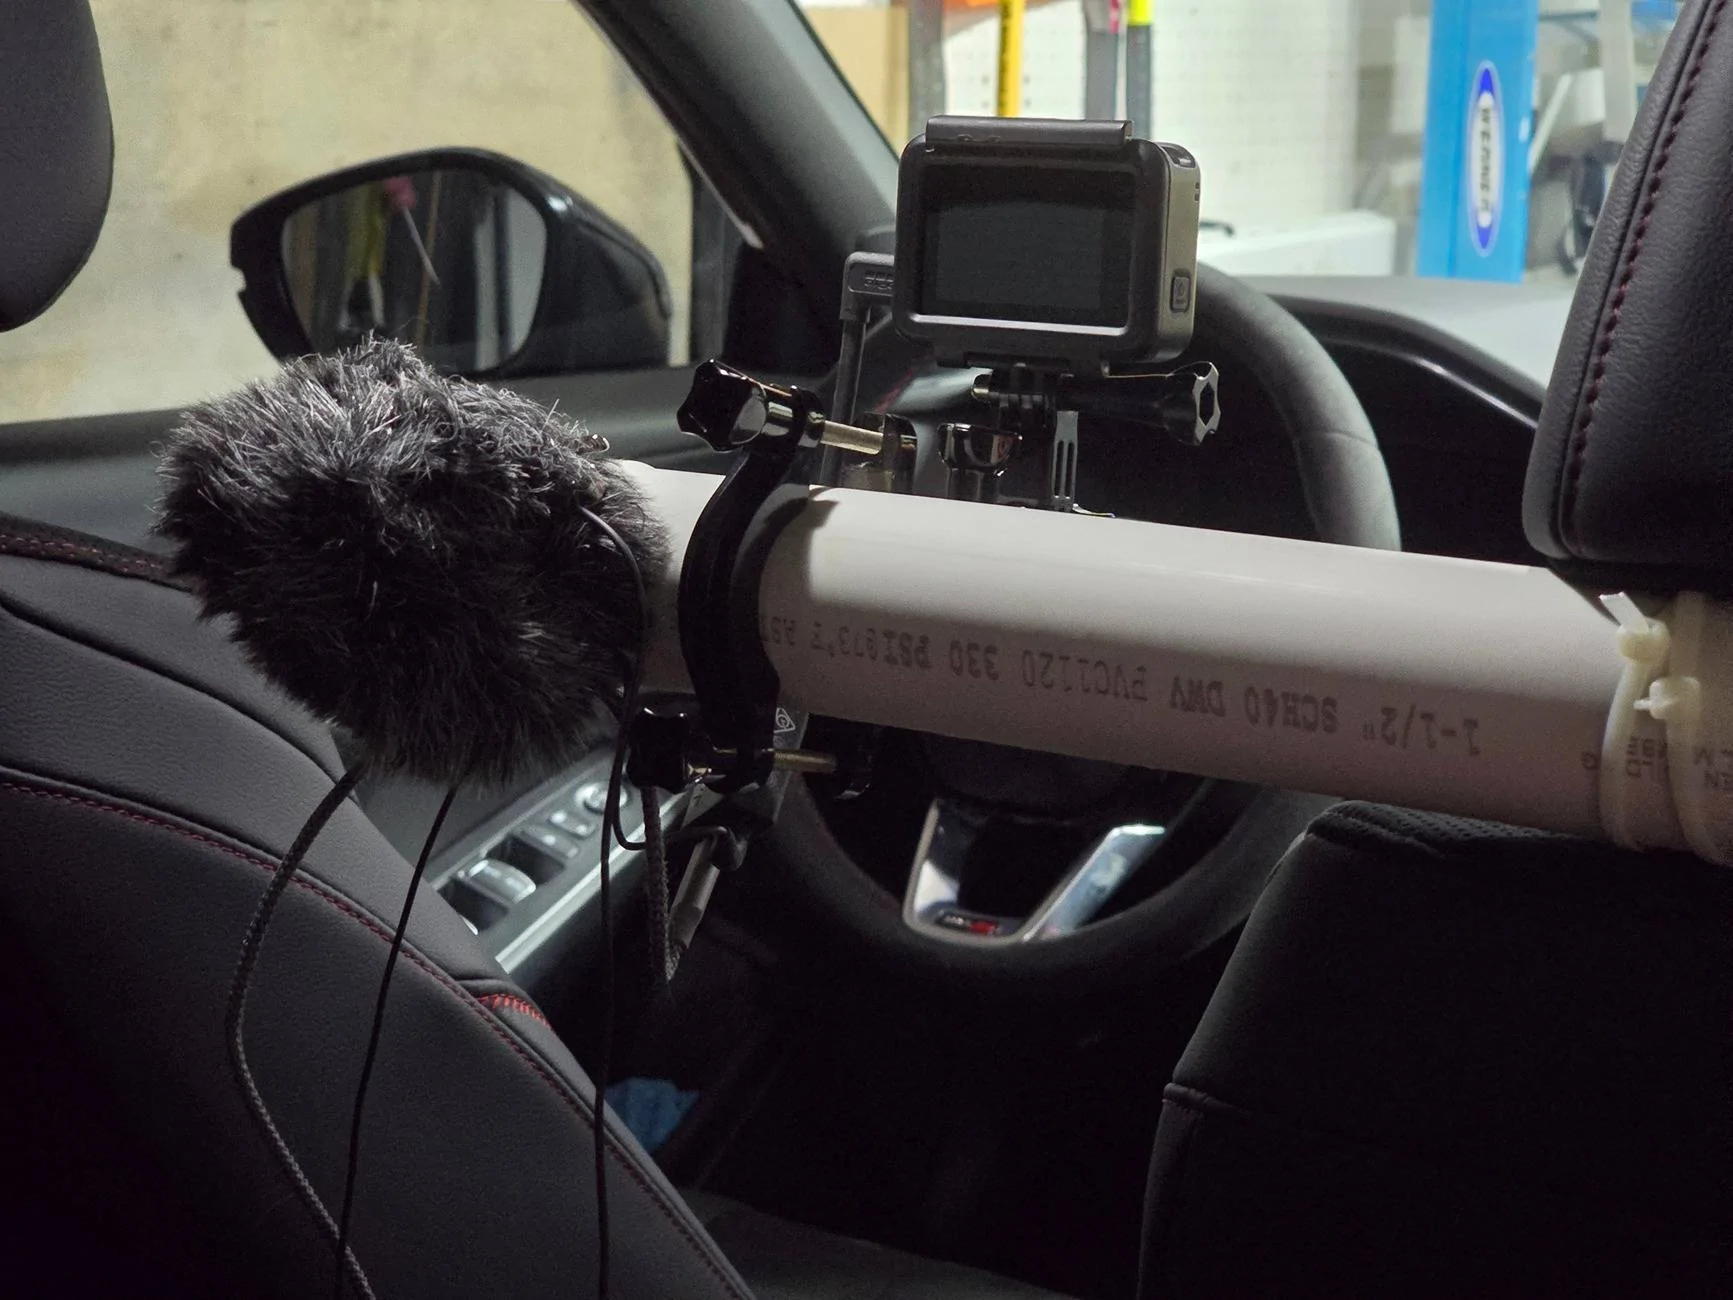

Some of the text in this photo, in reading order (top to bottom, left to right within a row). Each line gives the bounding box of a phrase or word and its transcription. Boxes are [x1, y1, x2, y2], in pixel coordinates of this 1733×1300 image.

[949, 640, 1000, 680] 330
[1022, 649, 1147, 701] PVC1120
[1171, 676, 1226, 717] DWV
[1244, 686, 1338, 733] SCH40
[1362, 703, 1481, 756] 1-1/2"
